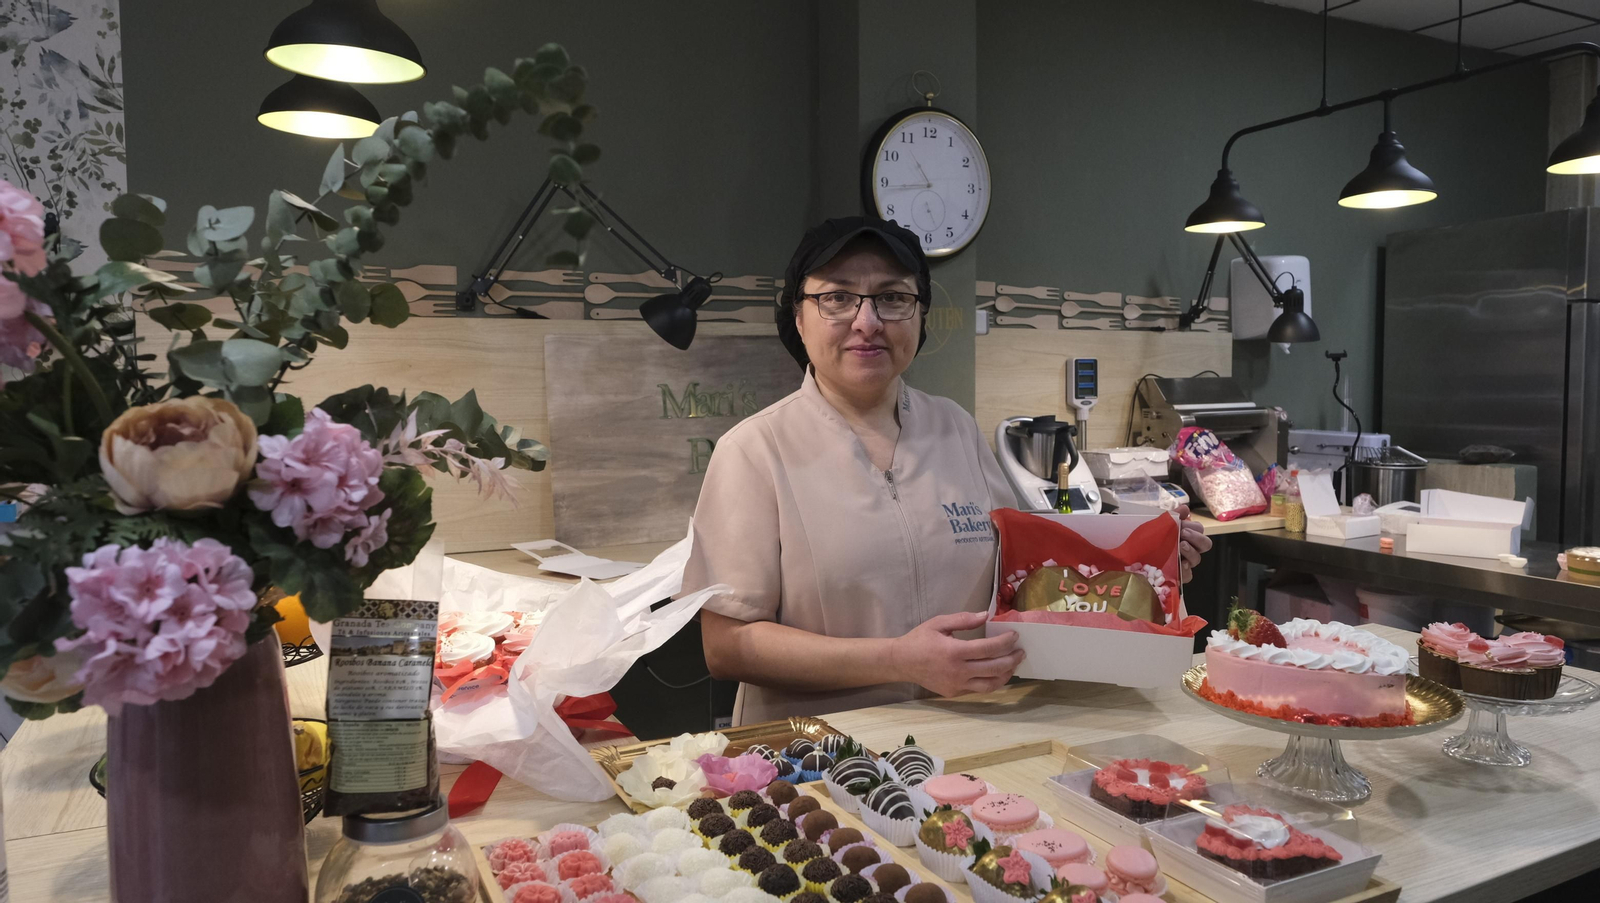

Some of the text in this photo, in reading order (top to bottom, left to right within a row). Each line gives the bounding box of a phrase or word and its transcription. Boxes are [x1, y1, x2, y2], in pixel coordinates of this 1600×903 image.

[901, 132, 914, 144] 11
[922, 127, 937, 139] 12
[947, 136, 953, 148] 1
[884, 150, 899, 162] 10
[962, 157, 970, 168] 2
[880, 177, 889, 188] 9
[967, 183, 975, 195] 3
[886, 204, 895, 216] 8
[961, 209, 970, 220] 4
[924, 233, 932, 244] 6
[945, 227, 954, 238] 5
[927, 307, 963, 329] UTEN
[656, 380, 758, 419] Mari's
[942, 501, 983, 518] Mari's
[1063, 568, 1069, 579] I
[1058, 580, 1122, 597] LOVE
[1064, 595, 1108, 613] YOU
[333, 619, 372, 628] Granada
[394, 621, 437, 631] Comany
[335, 657, 364, 668] Rooibos
[366, 658, 396, 667] Banana
